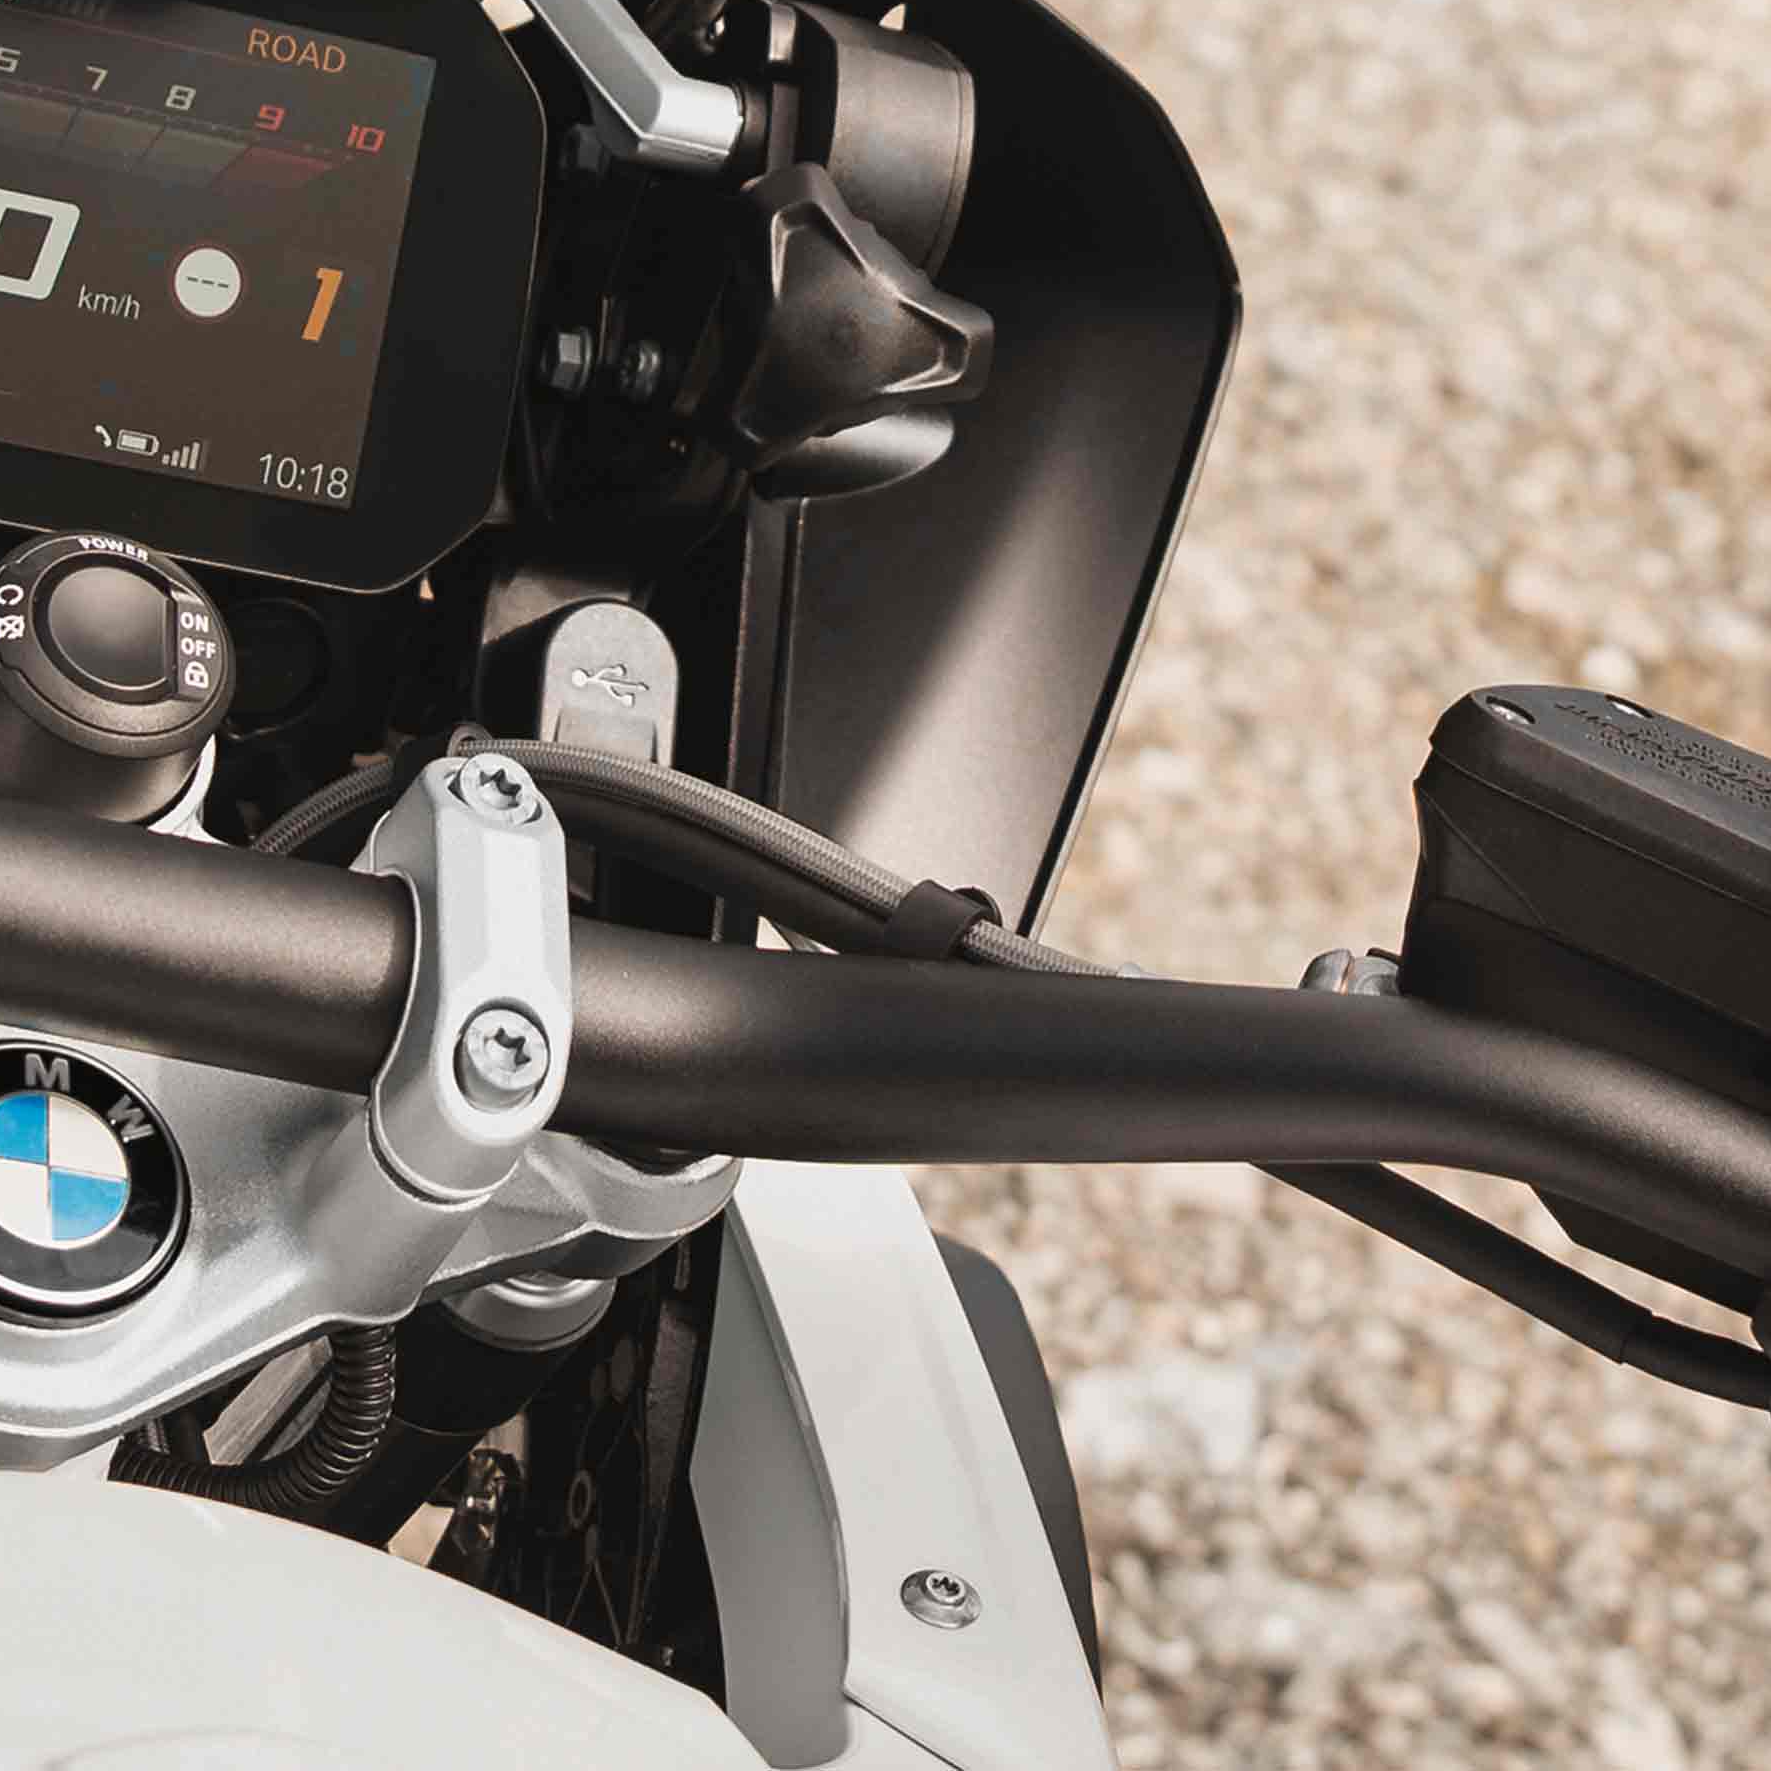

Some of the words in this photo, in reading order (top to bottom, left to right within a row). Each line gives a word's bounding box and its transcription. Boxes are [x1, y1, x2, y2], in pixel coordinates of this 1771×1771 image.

[247, 28, 346, 73] ROAD
[86, 65, 109, 91] 7
[165, 85, 196, 110] 8
[255, 104, 286, 131] 9
[346, 124, 387, 154] 10
[78, 285, 141, 320] km/h
[302, 268, 344, 342] 1
[259, 453, 349, 499] 10:18
[78, 536, 149, 562] POWER
[180, 611, 209, 633] ON
[181, 637, 217, 660] OFF
